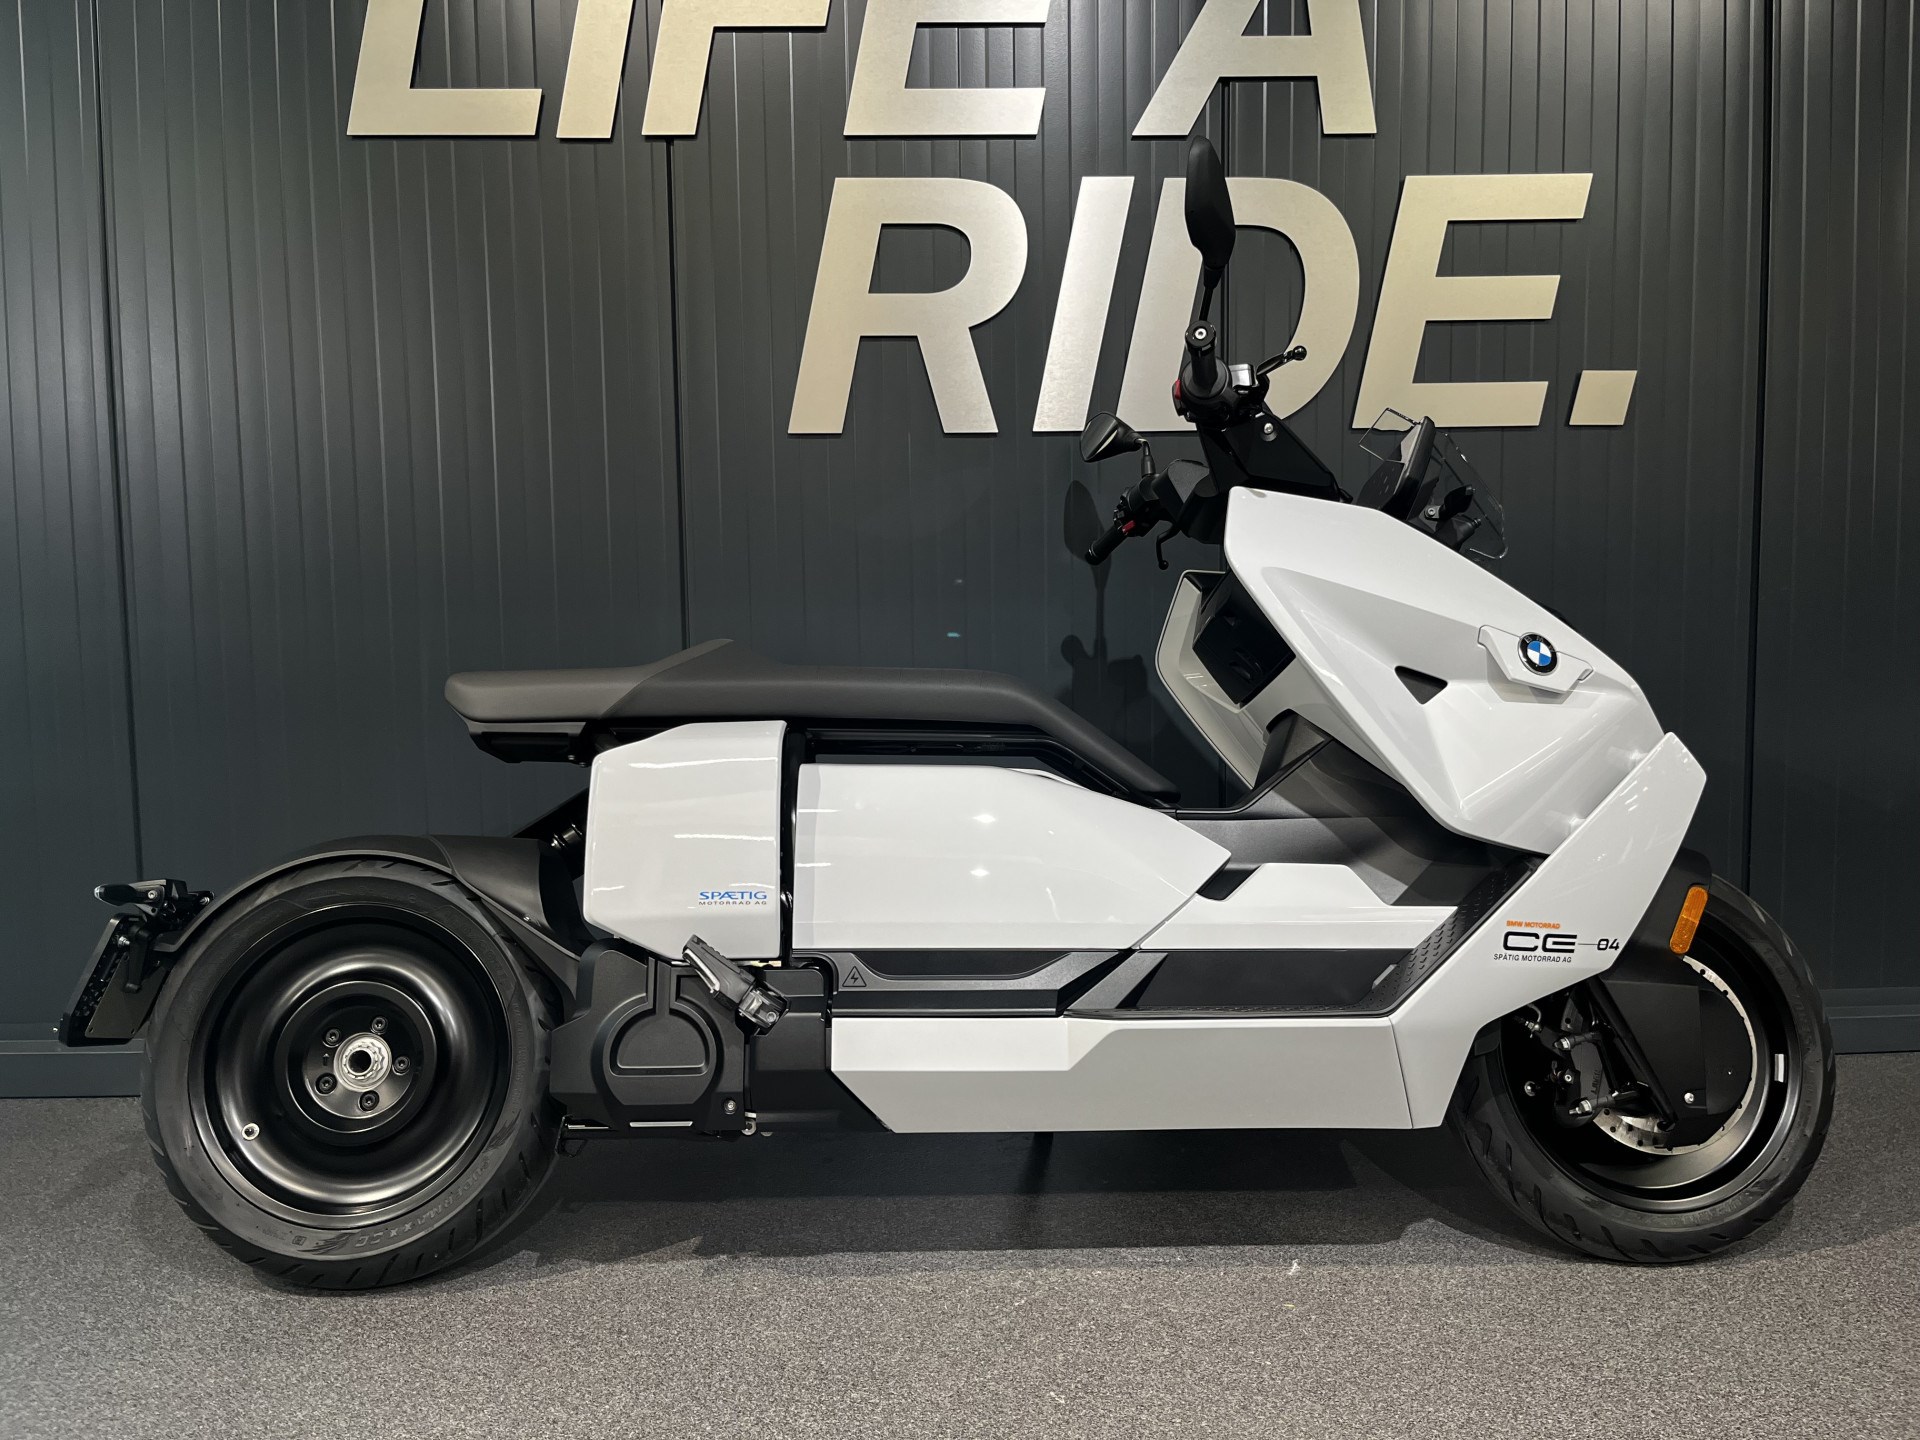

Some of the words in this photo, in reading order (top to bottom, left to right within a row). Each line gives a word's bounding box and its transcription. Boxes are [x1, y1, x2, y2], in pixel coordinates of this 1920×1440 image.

[787, 172, 1638, 436] RIDE.
[1506, 920, 1523, 928] BMW
[1524, 921, 1561, 930] MOTORRAD
[1520, 954, 1561, 963] MOTORRAD
